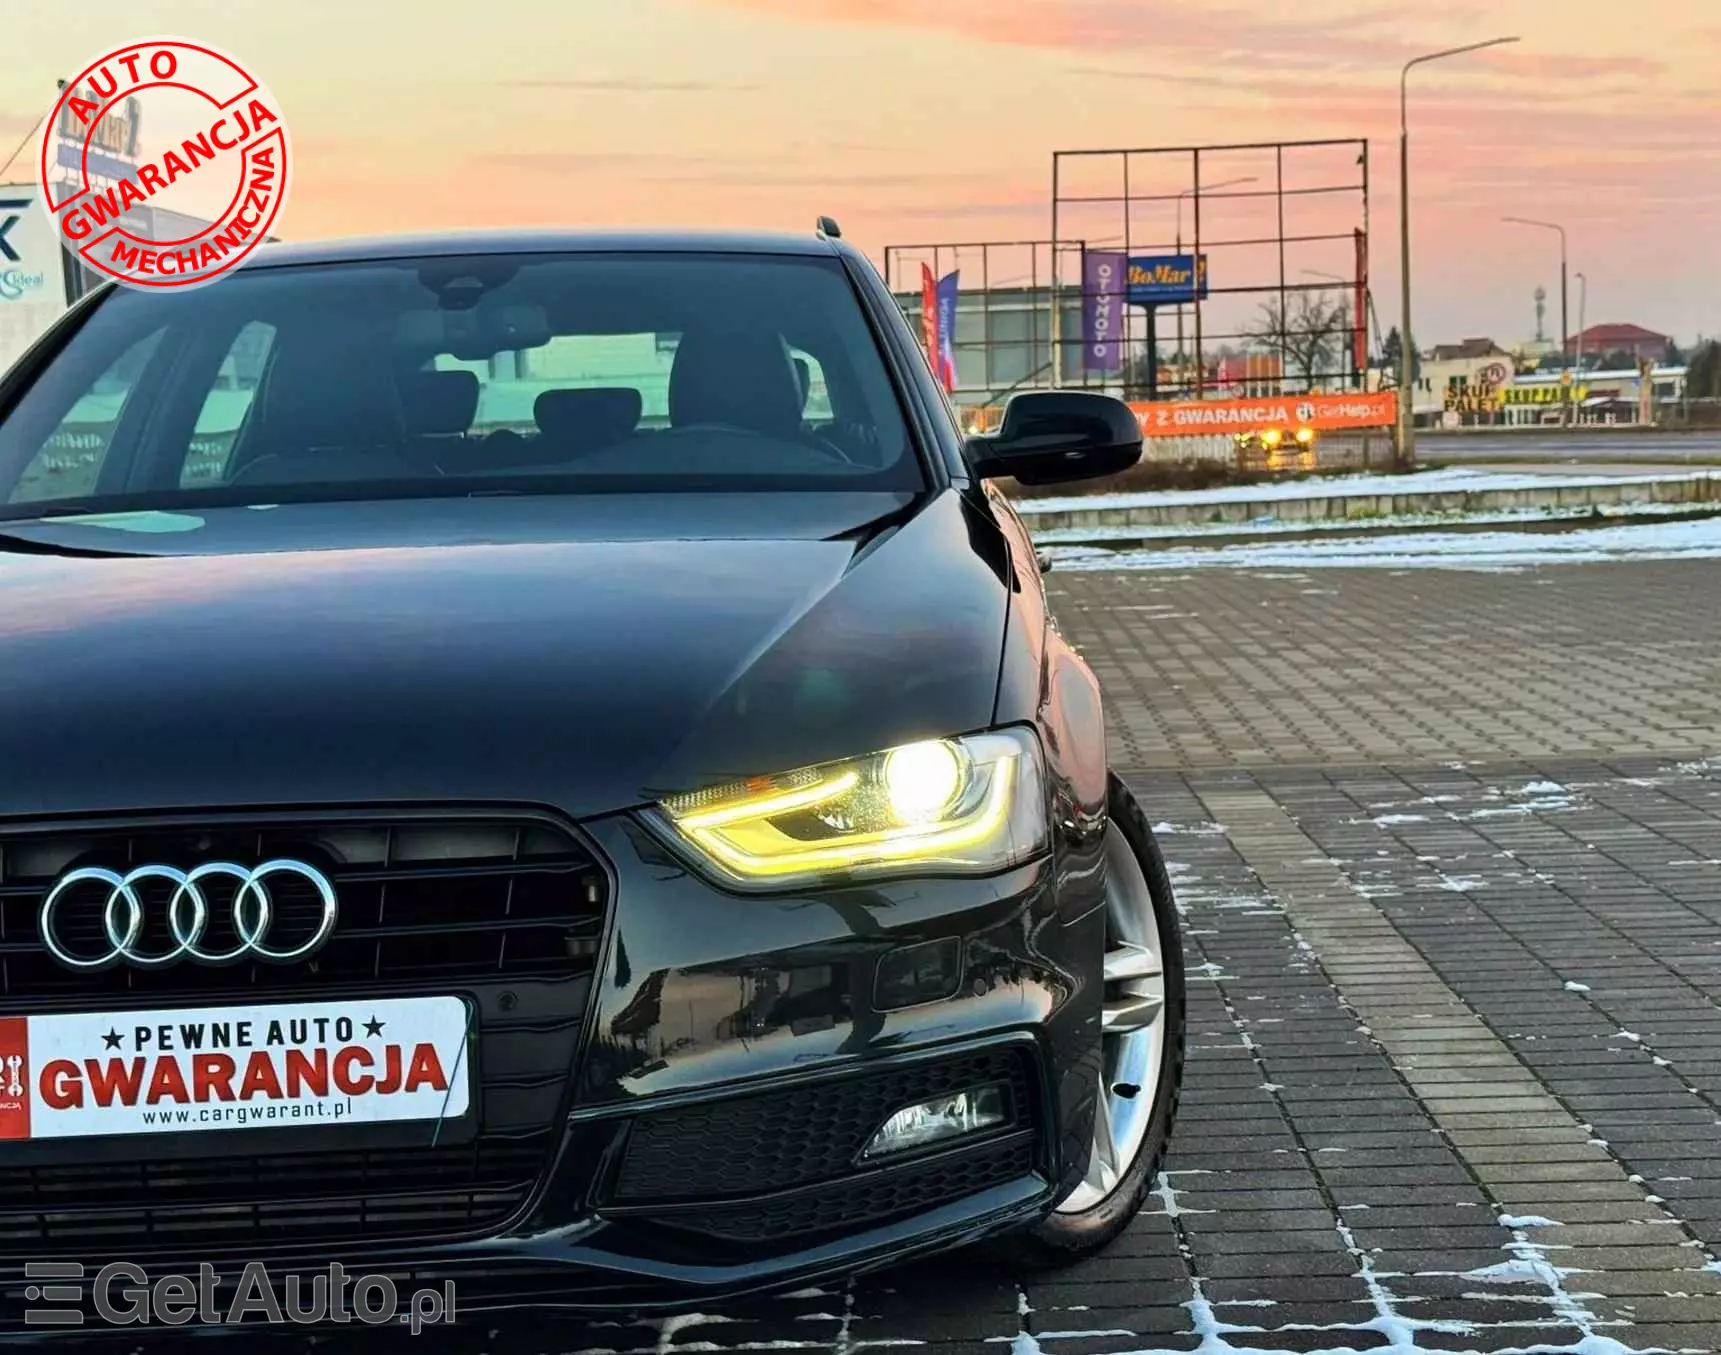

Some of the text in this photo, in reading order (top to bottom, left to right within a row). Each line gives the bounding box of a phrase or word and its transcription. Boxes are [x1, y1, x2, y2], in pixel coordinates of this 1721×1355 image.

[1093, 264, 1112, 358] OTOMOTO
[1156, 409, 1169, 427] Z
[135, 1015, 353, 1051] PEWNE AUTO
[39, 1042, 448, 1110] GWARANCJA
[142, 1096, 352, 1126] www.cargwarant.pl
